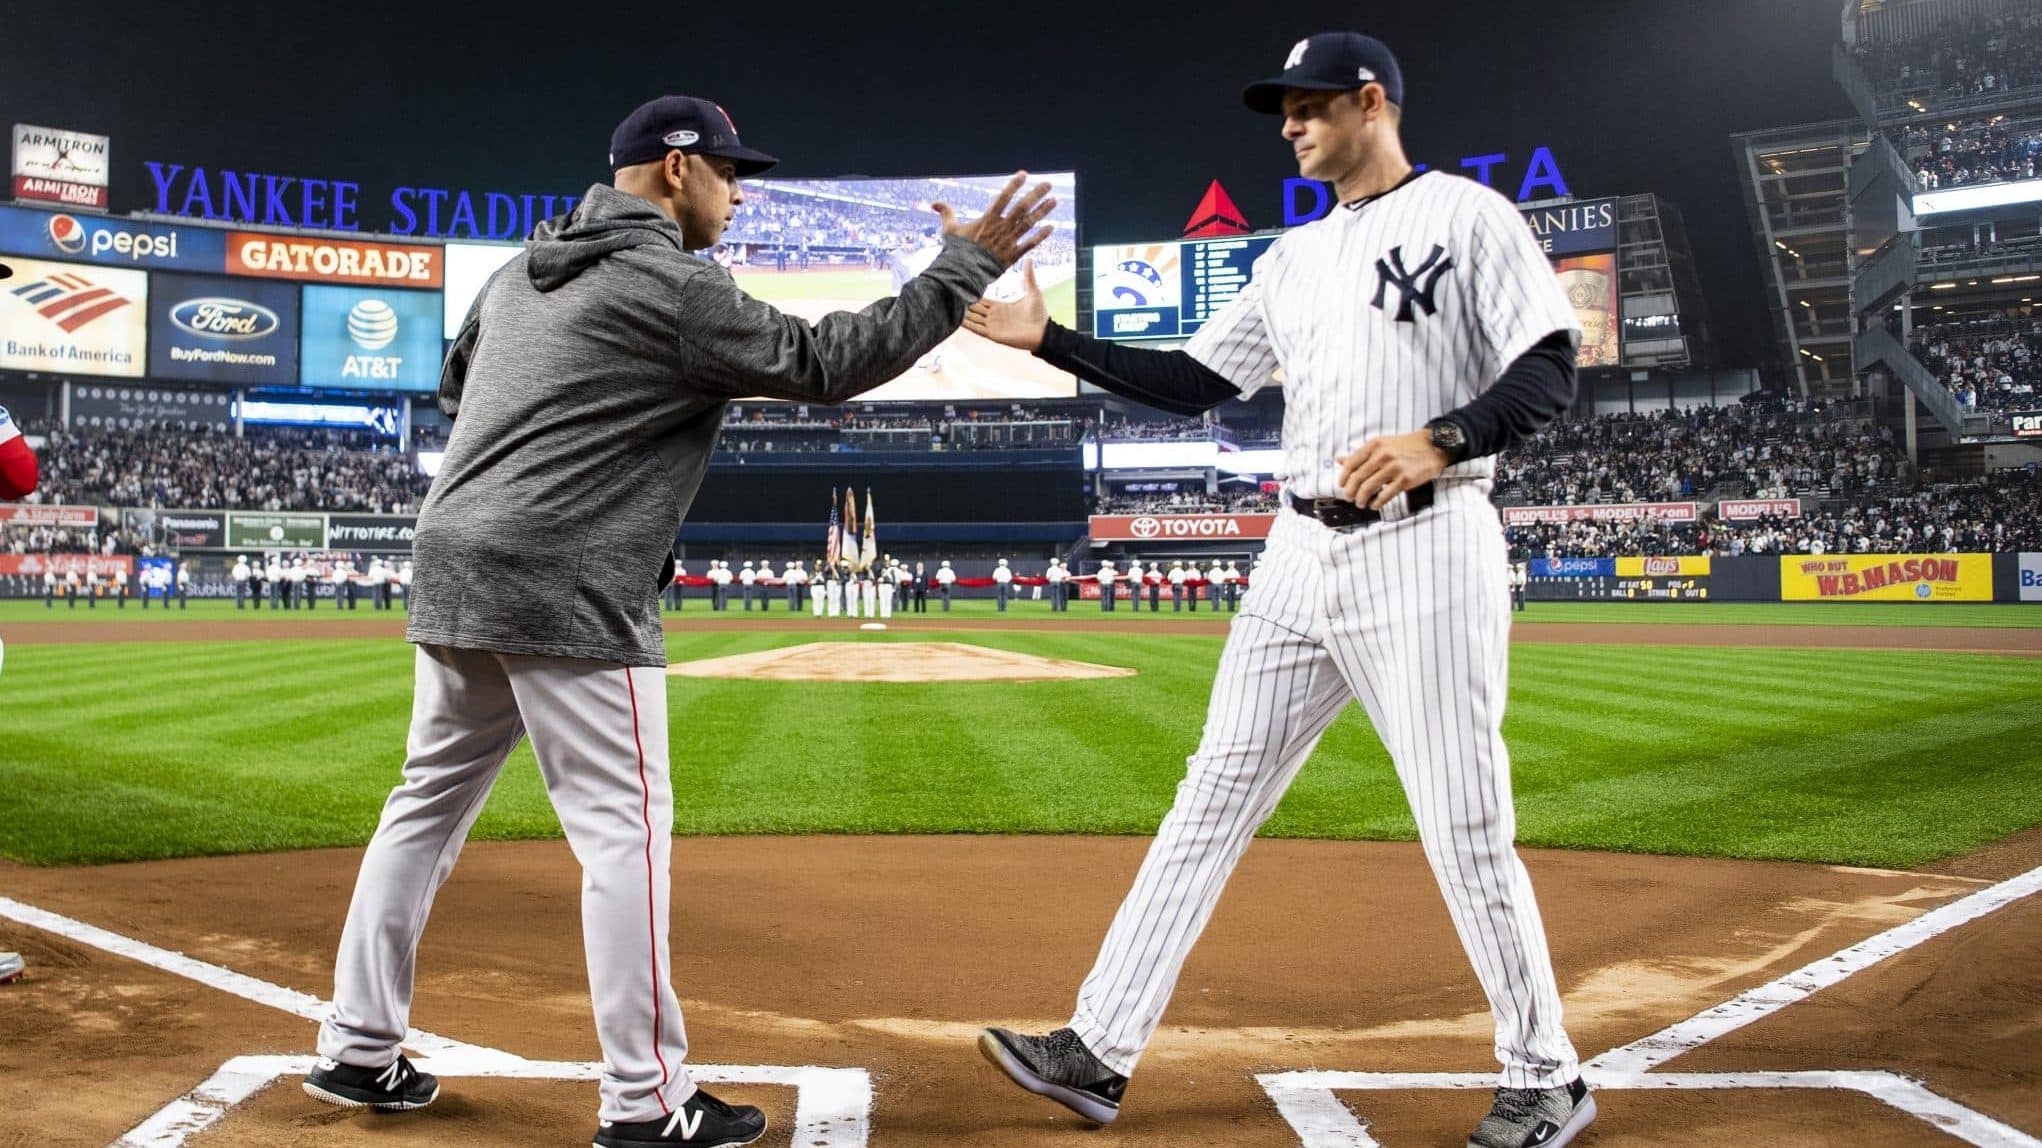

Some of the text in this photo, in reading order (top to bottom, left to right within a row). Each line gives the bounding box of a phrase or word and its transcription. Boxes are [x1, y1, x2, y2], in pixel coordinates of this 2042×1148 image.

[21, 133, 105, 155] ARMITRON
[23, 178, 99, 201] ARMITRON
[144, 161, 360, 231] YANKEE
[1282, 145, 1569, 226] DTA
[92, 230, 177, 260] pepsi
[240, 241, 432, 280] GATORADE
[1370, 243, 1453, 322] NY
[191, 303, 258, 333] Ford
[7, 340, 132, 363] Bank of America
[171, 347, 276, 366] BuyFordNow.com
[342, 357, 402, 378] AT&T
[1161, 519, 1240, 535] TOYOTA
[1564, 559, 1598, 572] pepsi
[1801, 561, 1848, 574] WHO BUT
[660, 1106, 704, 1140] N
